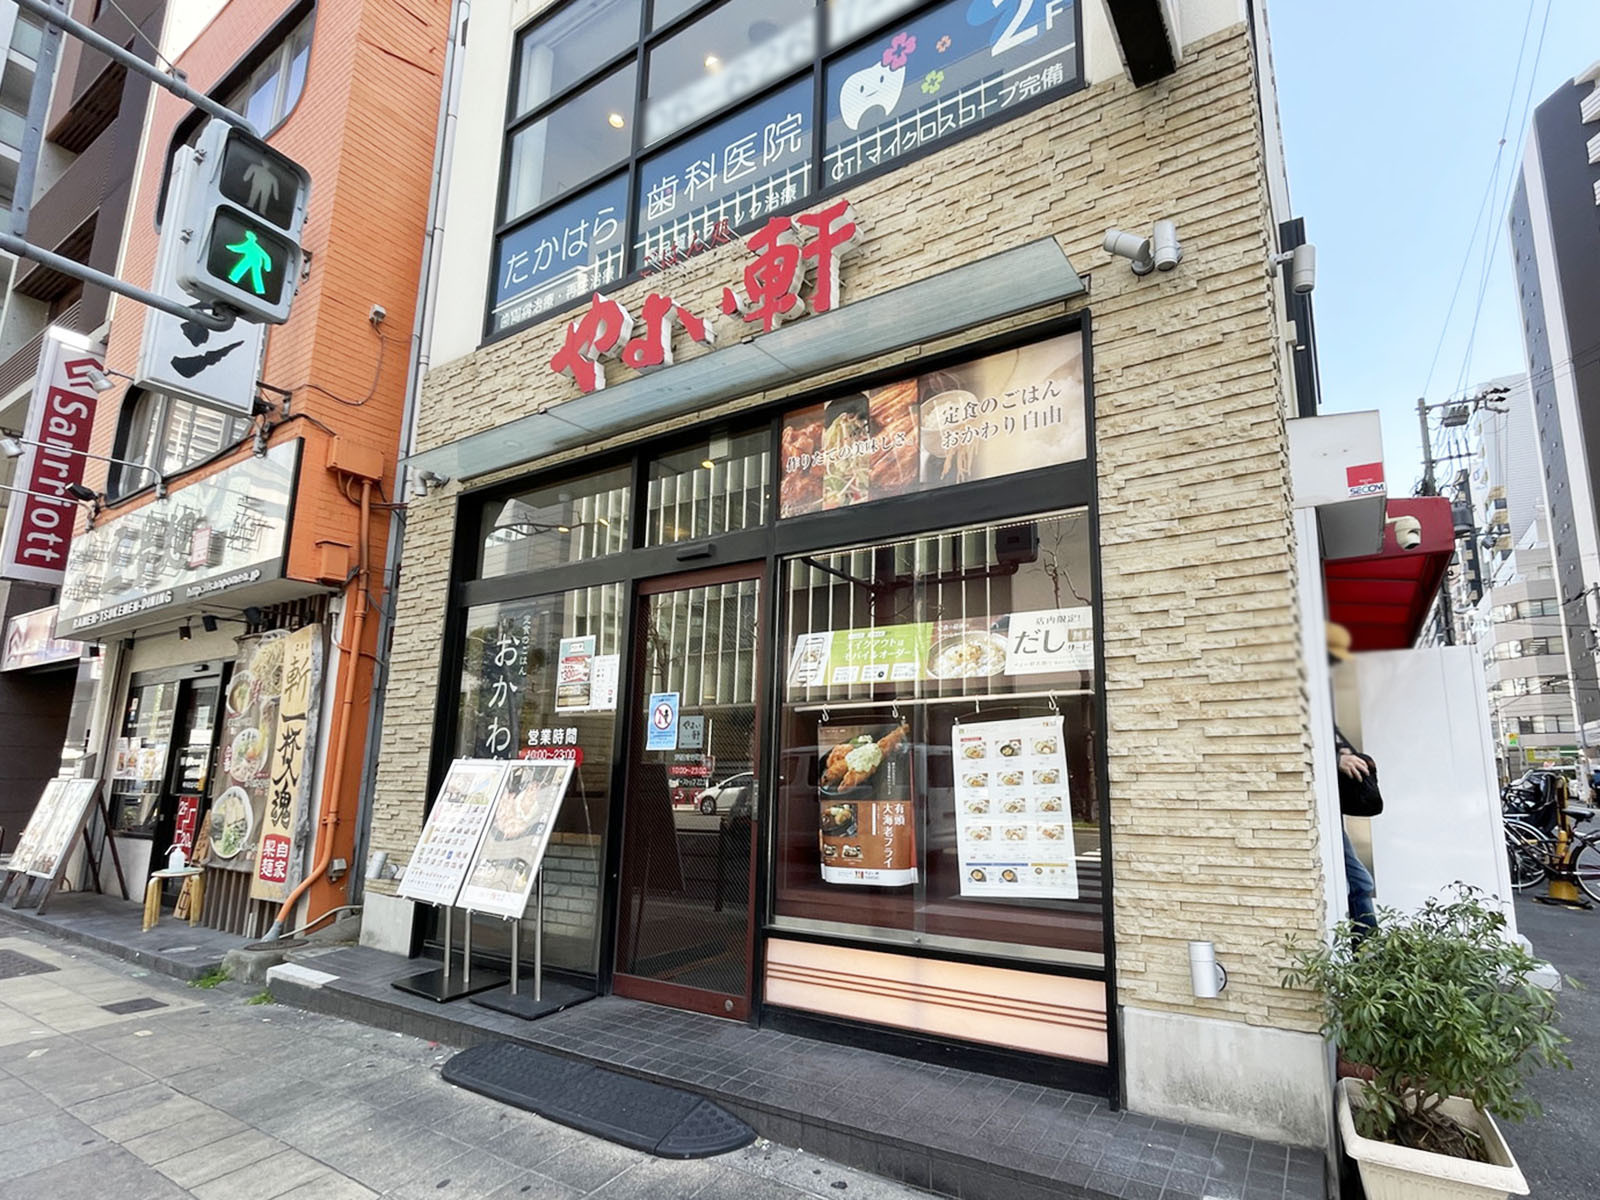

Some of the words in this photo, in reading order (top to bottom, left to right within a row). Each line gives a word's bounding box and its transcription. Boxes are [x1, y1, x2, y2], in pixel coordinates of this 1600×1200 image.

[504, 207, 618, 289] たかはら
[646, 113, 802, 221] 歯科医院
[550, 200, 860, 393] やよい軒
[942, 380, 1061, 426] 定食のごはん
[941, 407, 1063, 450] おかわり自由
[22, 394, 89, 563] Sanrriott
[1350, 483, 1384, 495] SECOM
[1014, 629, 1066, 655] だし
[486, 633, 521, 759] おかわ
[527, 727, 578, 746] 営業時間
[271, 713, 307, 830] 一杯入魂
[273, 841, 289, 879] 自家
